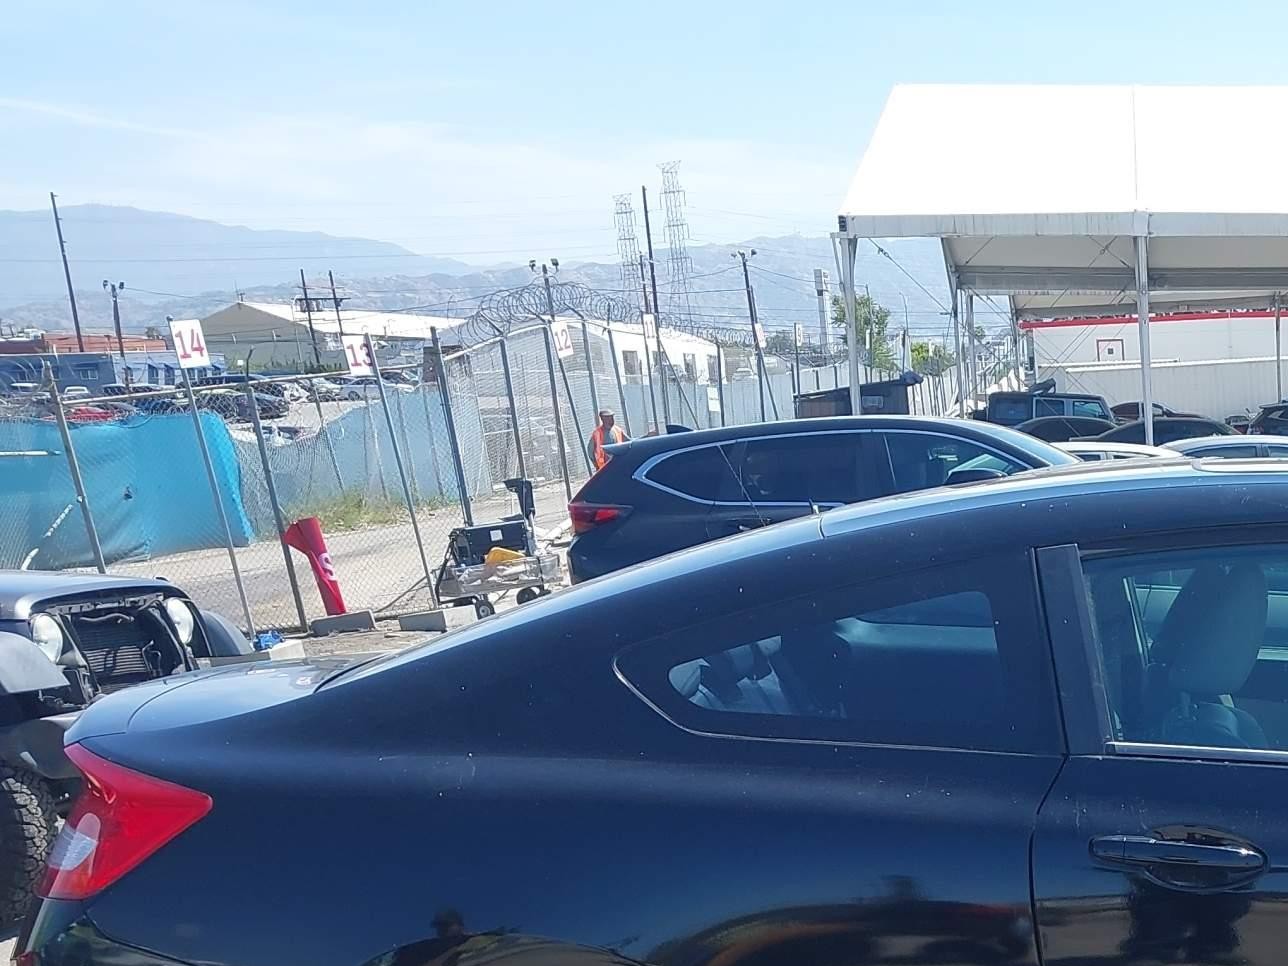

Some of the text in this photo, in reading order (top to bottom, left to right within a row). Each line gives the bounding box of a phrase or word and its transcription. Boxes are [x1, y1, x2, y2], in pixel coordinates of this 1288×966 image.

[175, 329, 204, 359] 14
[555, 329, 571, 351] 12
[346, 343, 373, 367] 13
